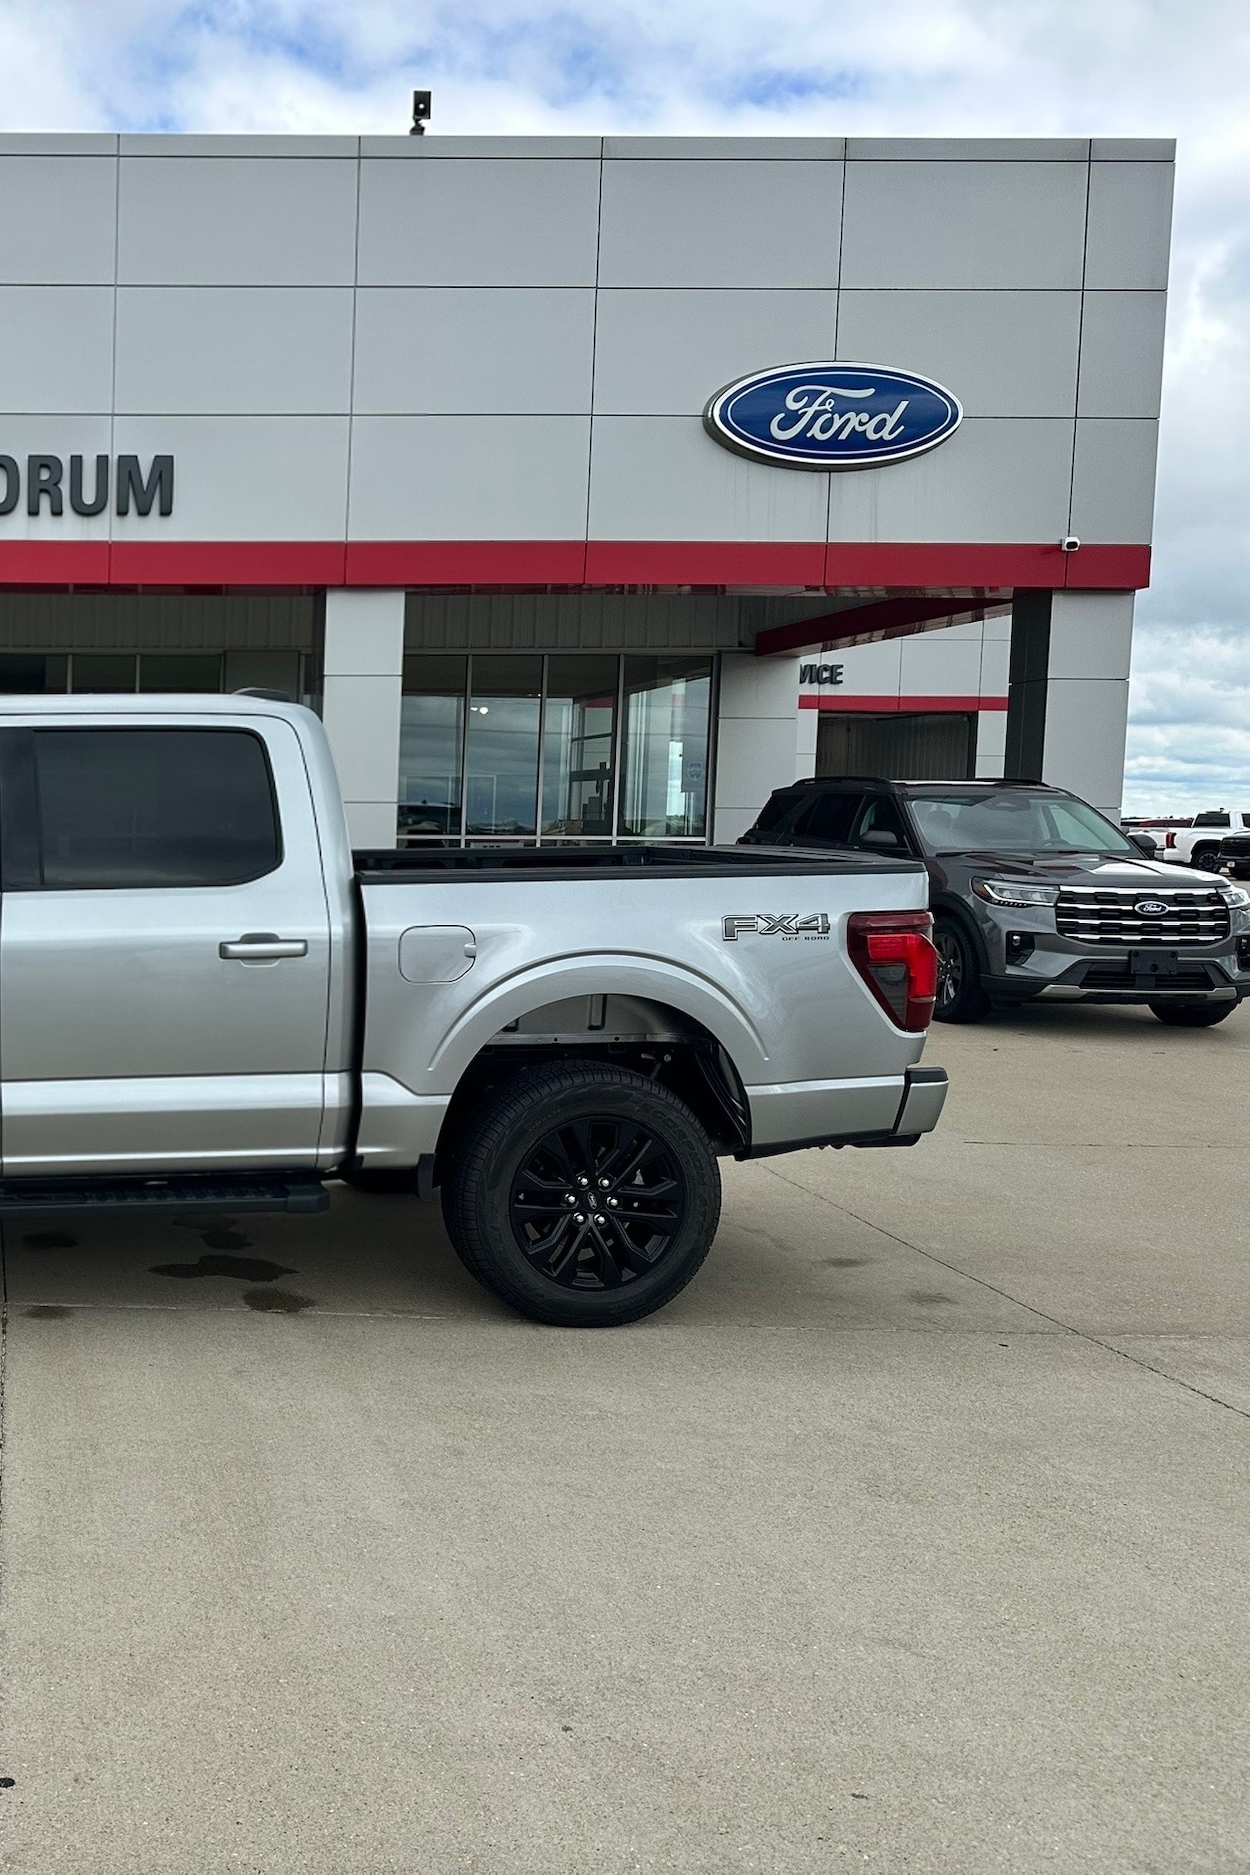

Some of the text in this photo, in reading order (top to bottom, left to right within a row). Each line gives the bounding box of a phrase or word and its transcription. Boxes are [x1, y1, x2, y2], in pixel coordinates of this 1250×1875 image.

[770, 385, 910, 441] Ford
[799, 664, 844, 684] VICE
[721, 913, 830, 941] FX4
